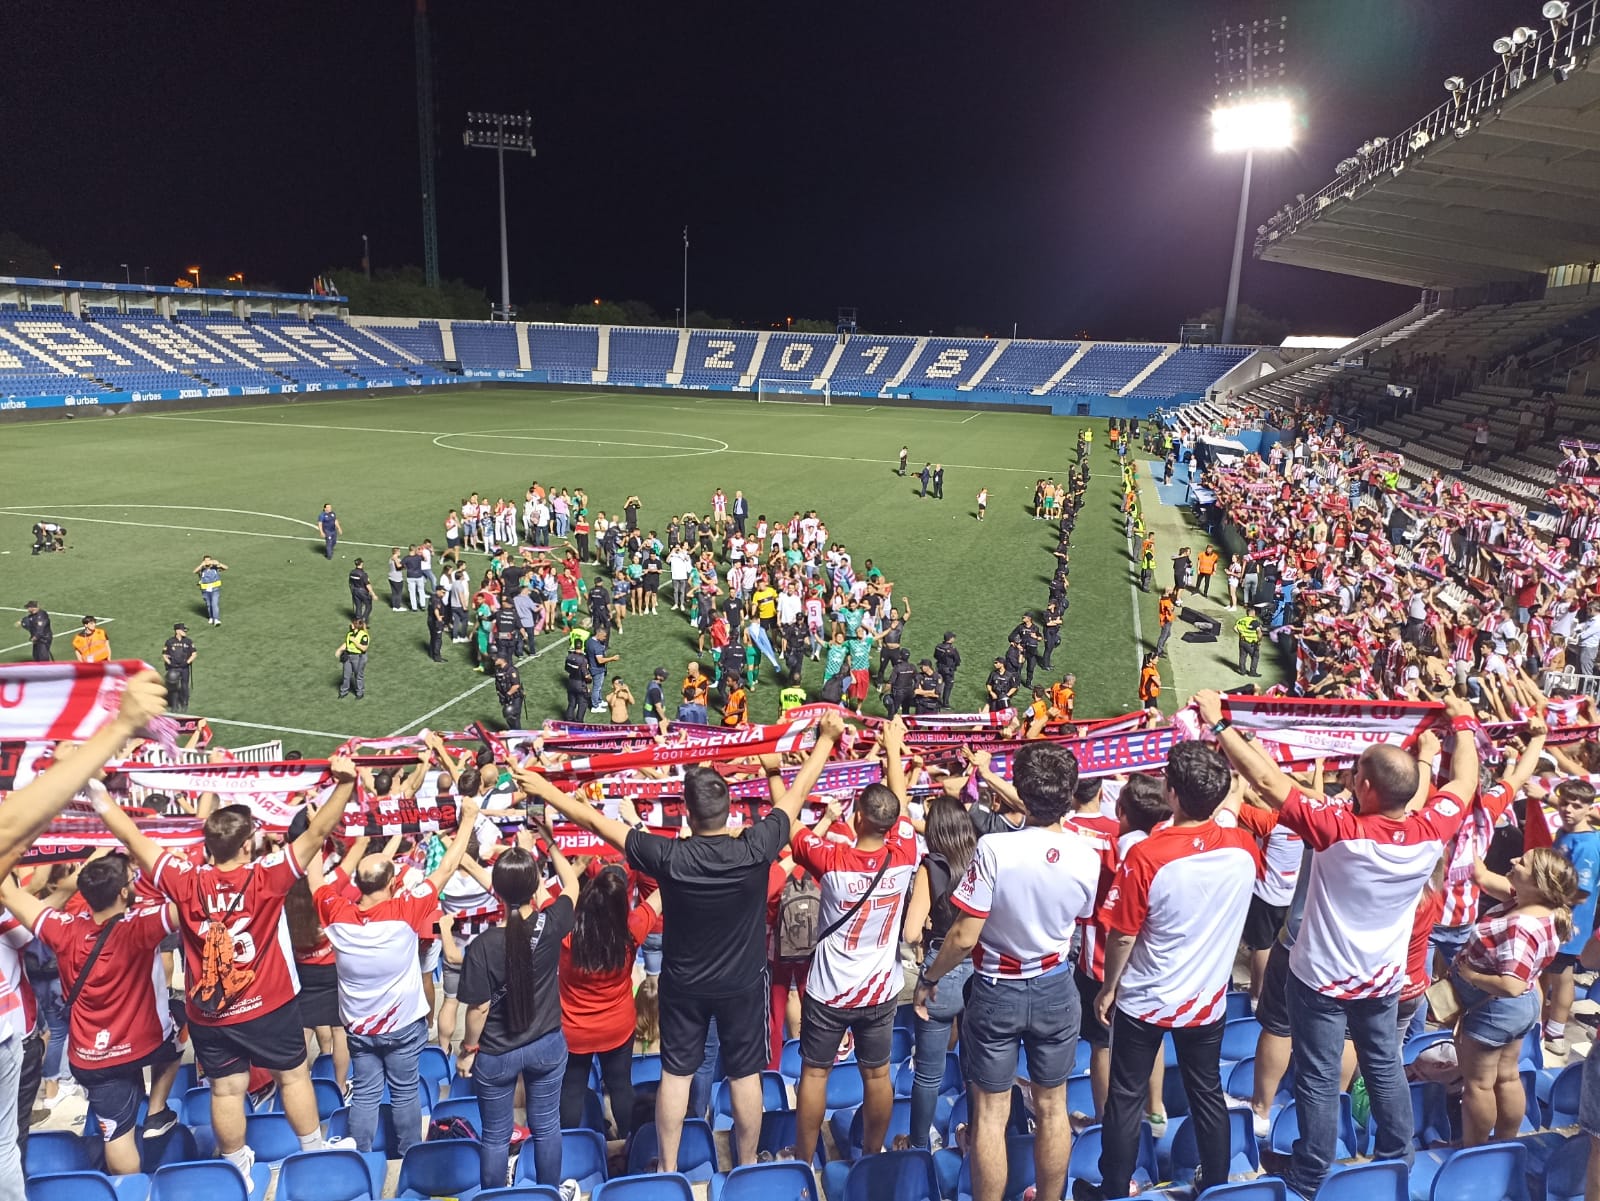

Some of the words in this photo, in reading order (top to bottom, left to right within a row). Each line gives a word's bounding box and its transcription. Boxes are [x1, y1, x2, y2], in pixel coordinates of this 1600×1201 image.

[281, 384, 298, 393] KFC
[306, 383, 322, 392] KFC
[76, 395, 99, 405] urbas
[142, 392, 162, 401] urbas
[1, 400, 27, 410] urbas
[783, 694, 799, 702] NCS
[653, 748, 720, 762] 2001-2021
[839, 893, 901, 952] 77
